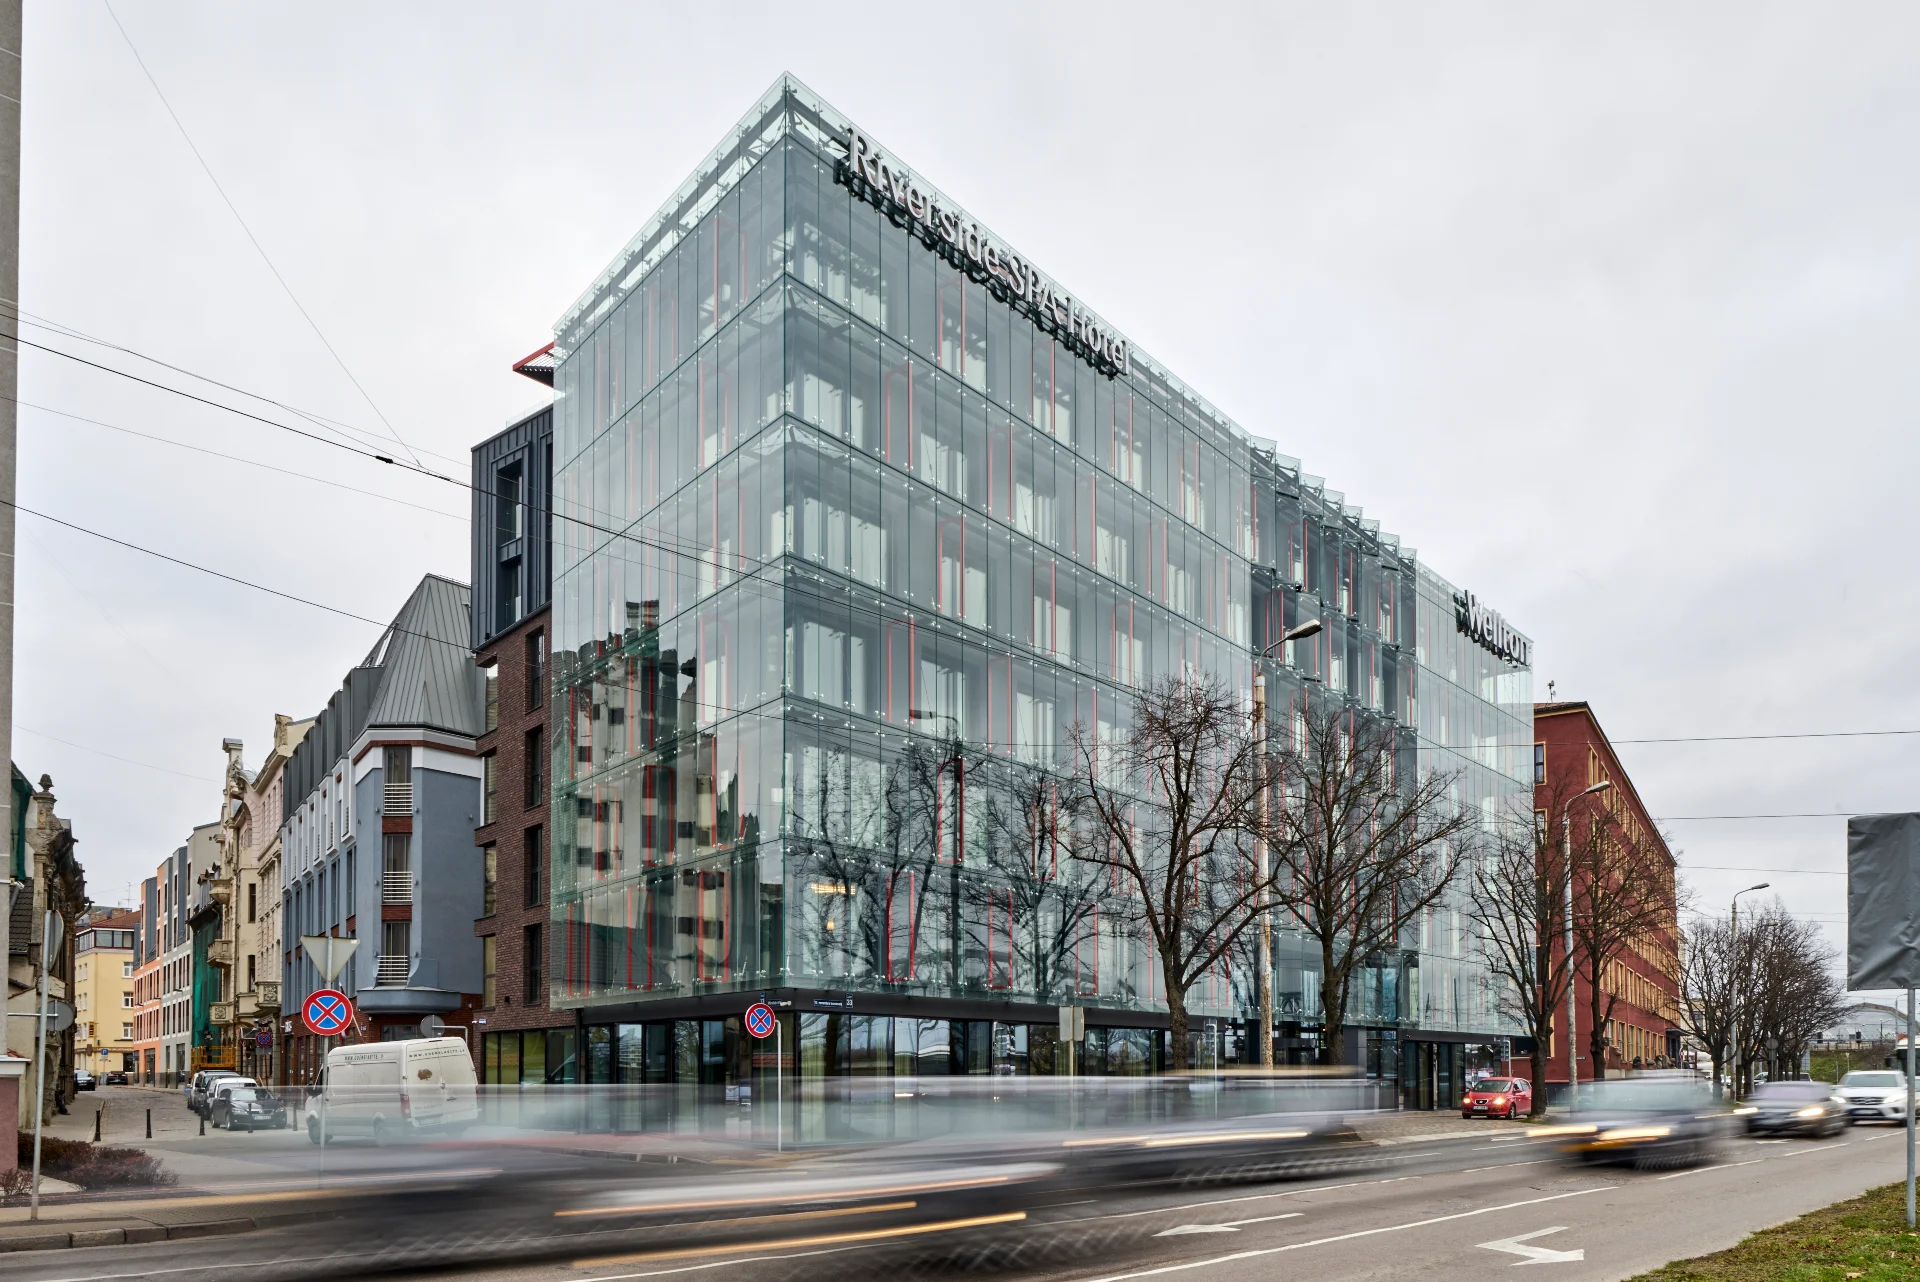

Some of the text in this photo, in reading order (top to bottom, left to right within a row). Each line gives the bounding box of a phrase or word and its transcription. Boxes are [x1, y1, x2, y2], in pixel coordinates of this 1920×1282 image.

[847, 127, 1130, 376] Riverside SPA Hotel
[1464, 589, 1527, 665] Wellton
